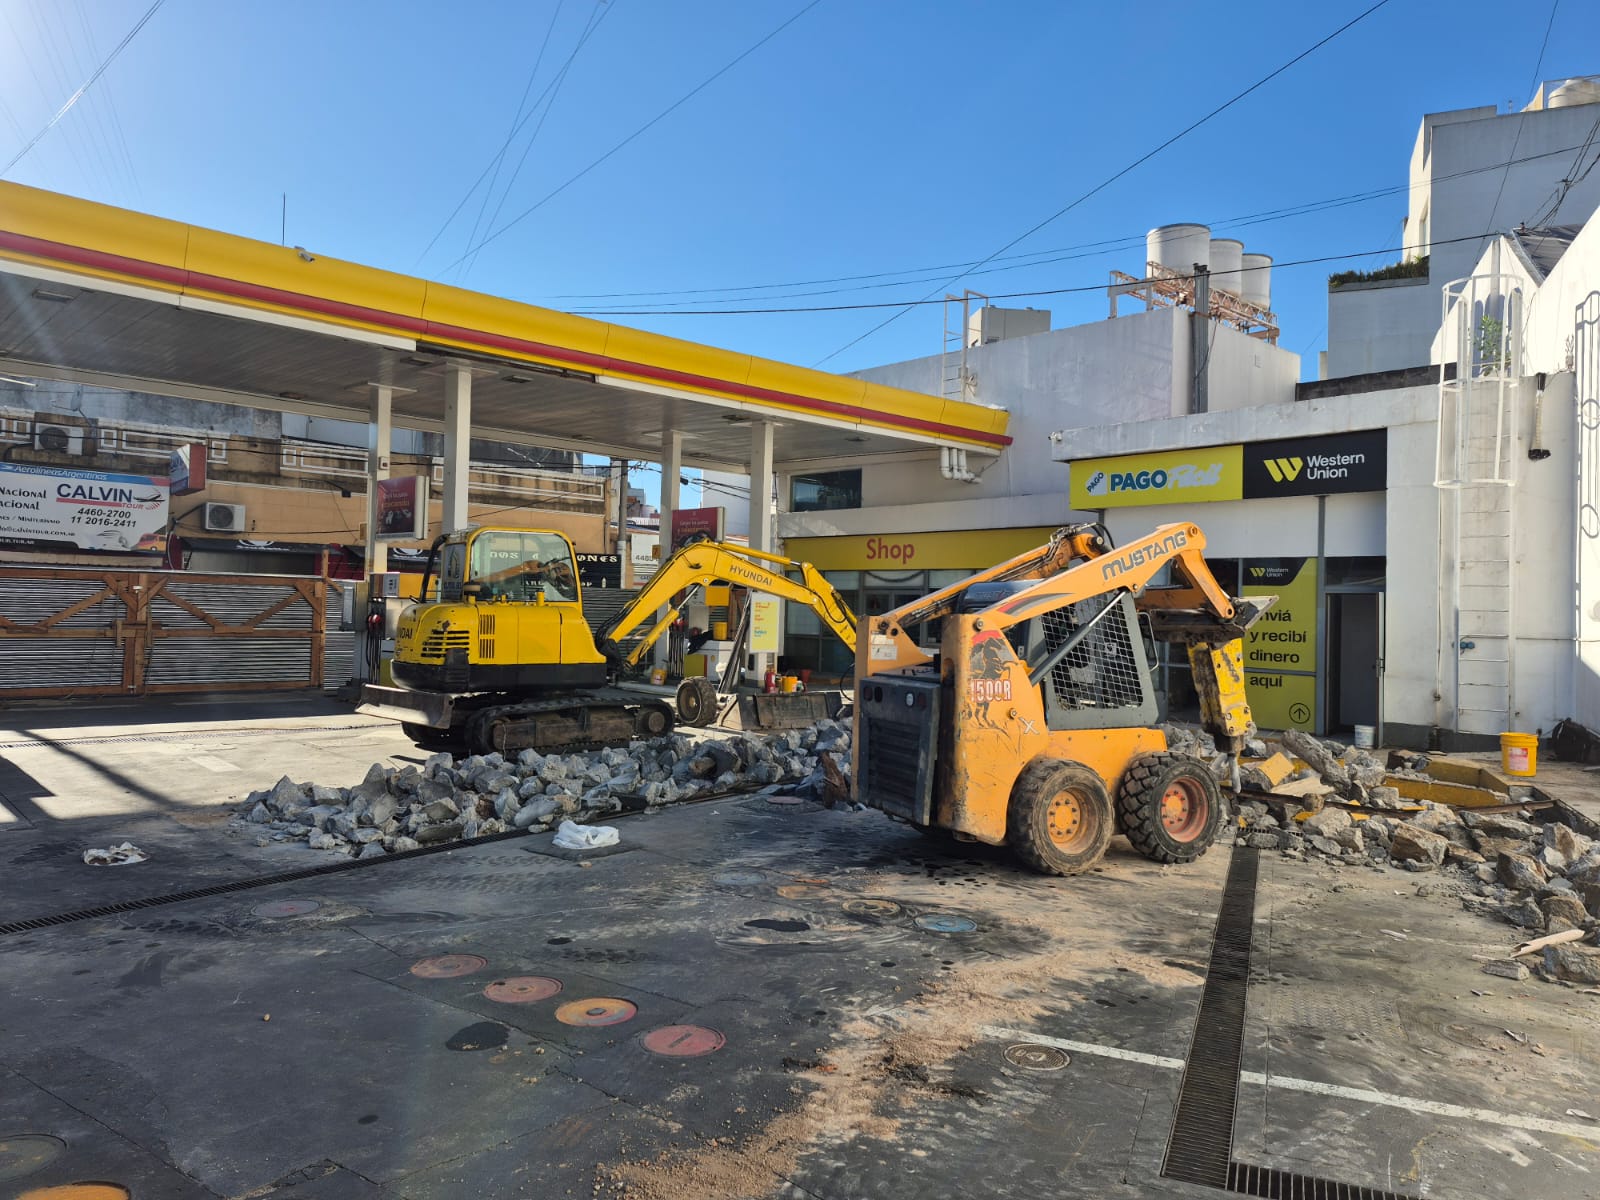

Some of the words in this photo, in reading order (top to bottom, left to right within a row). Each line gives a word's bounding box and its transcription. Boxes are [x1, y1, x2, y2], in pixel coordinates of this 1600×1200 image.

[1306, 453, 1365, 468] Western
[1306, 466, 1348, 480] Union
[1086, 472, 1104, 493] PAGO
[1109, 470, 1168, 492] PAGO
[56, 483, 133, 503] CALVIN
[77, 507, 132, 519] 4460-2700
[121, 502, 144, 510] TOUR
[71, 515, 82, 524] 11
[85, 516, 137, 528] 2016-2411
[866, 537, 915, 564] Shop
[1102, 530, 1188, 582] MUSTANG
[729, 564, 773, 587] HYUNDAI
[1259, 609, 1292, 622] nviá
[1250, 631, 1259, 644] y
[1262, 630, 1307, 643] recibí
[1249, 649, 1300, 664] dinero
[1250, 675, 1283, 689] aquí
[970, 678, 1012, 702] 1500R
